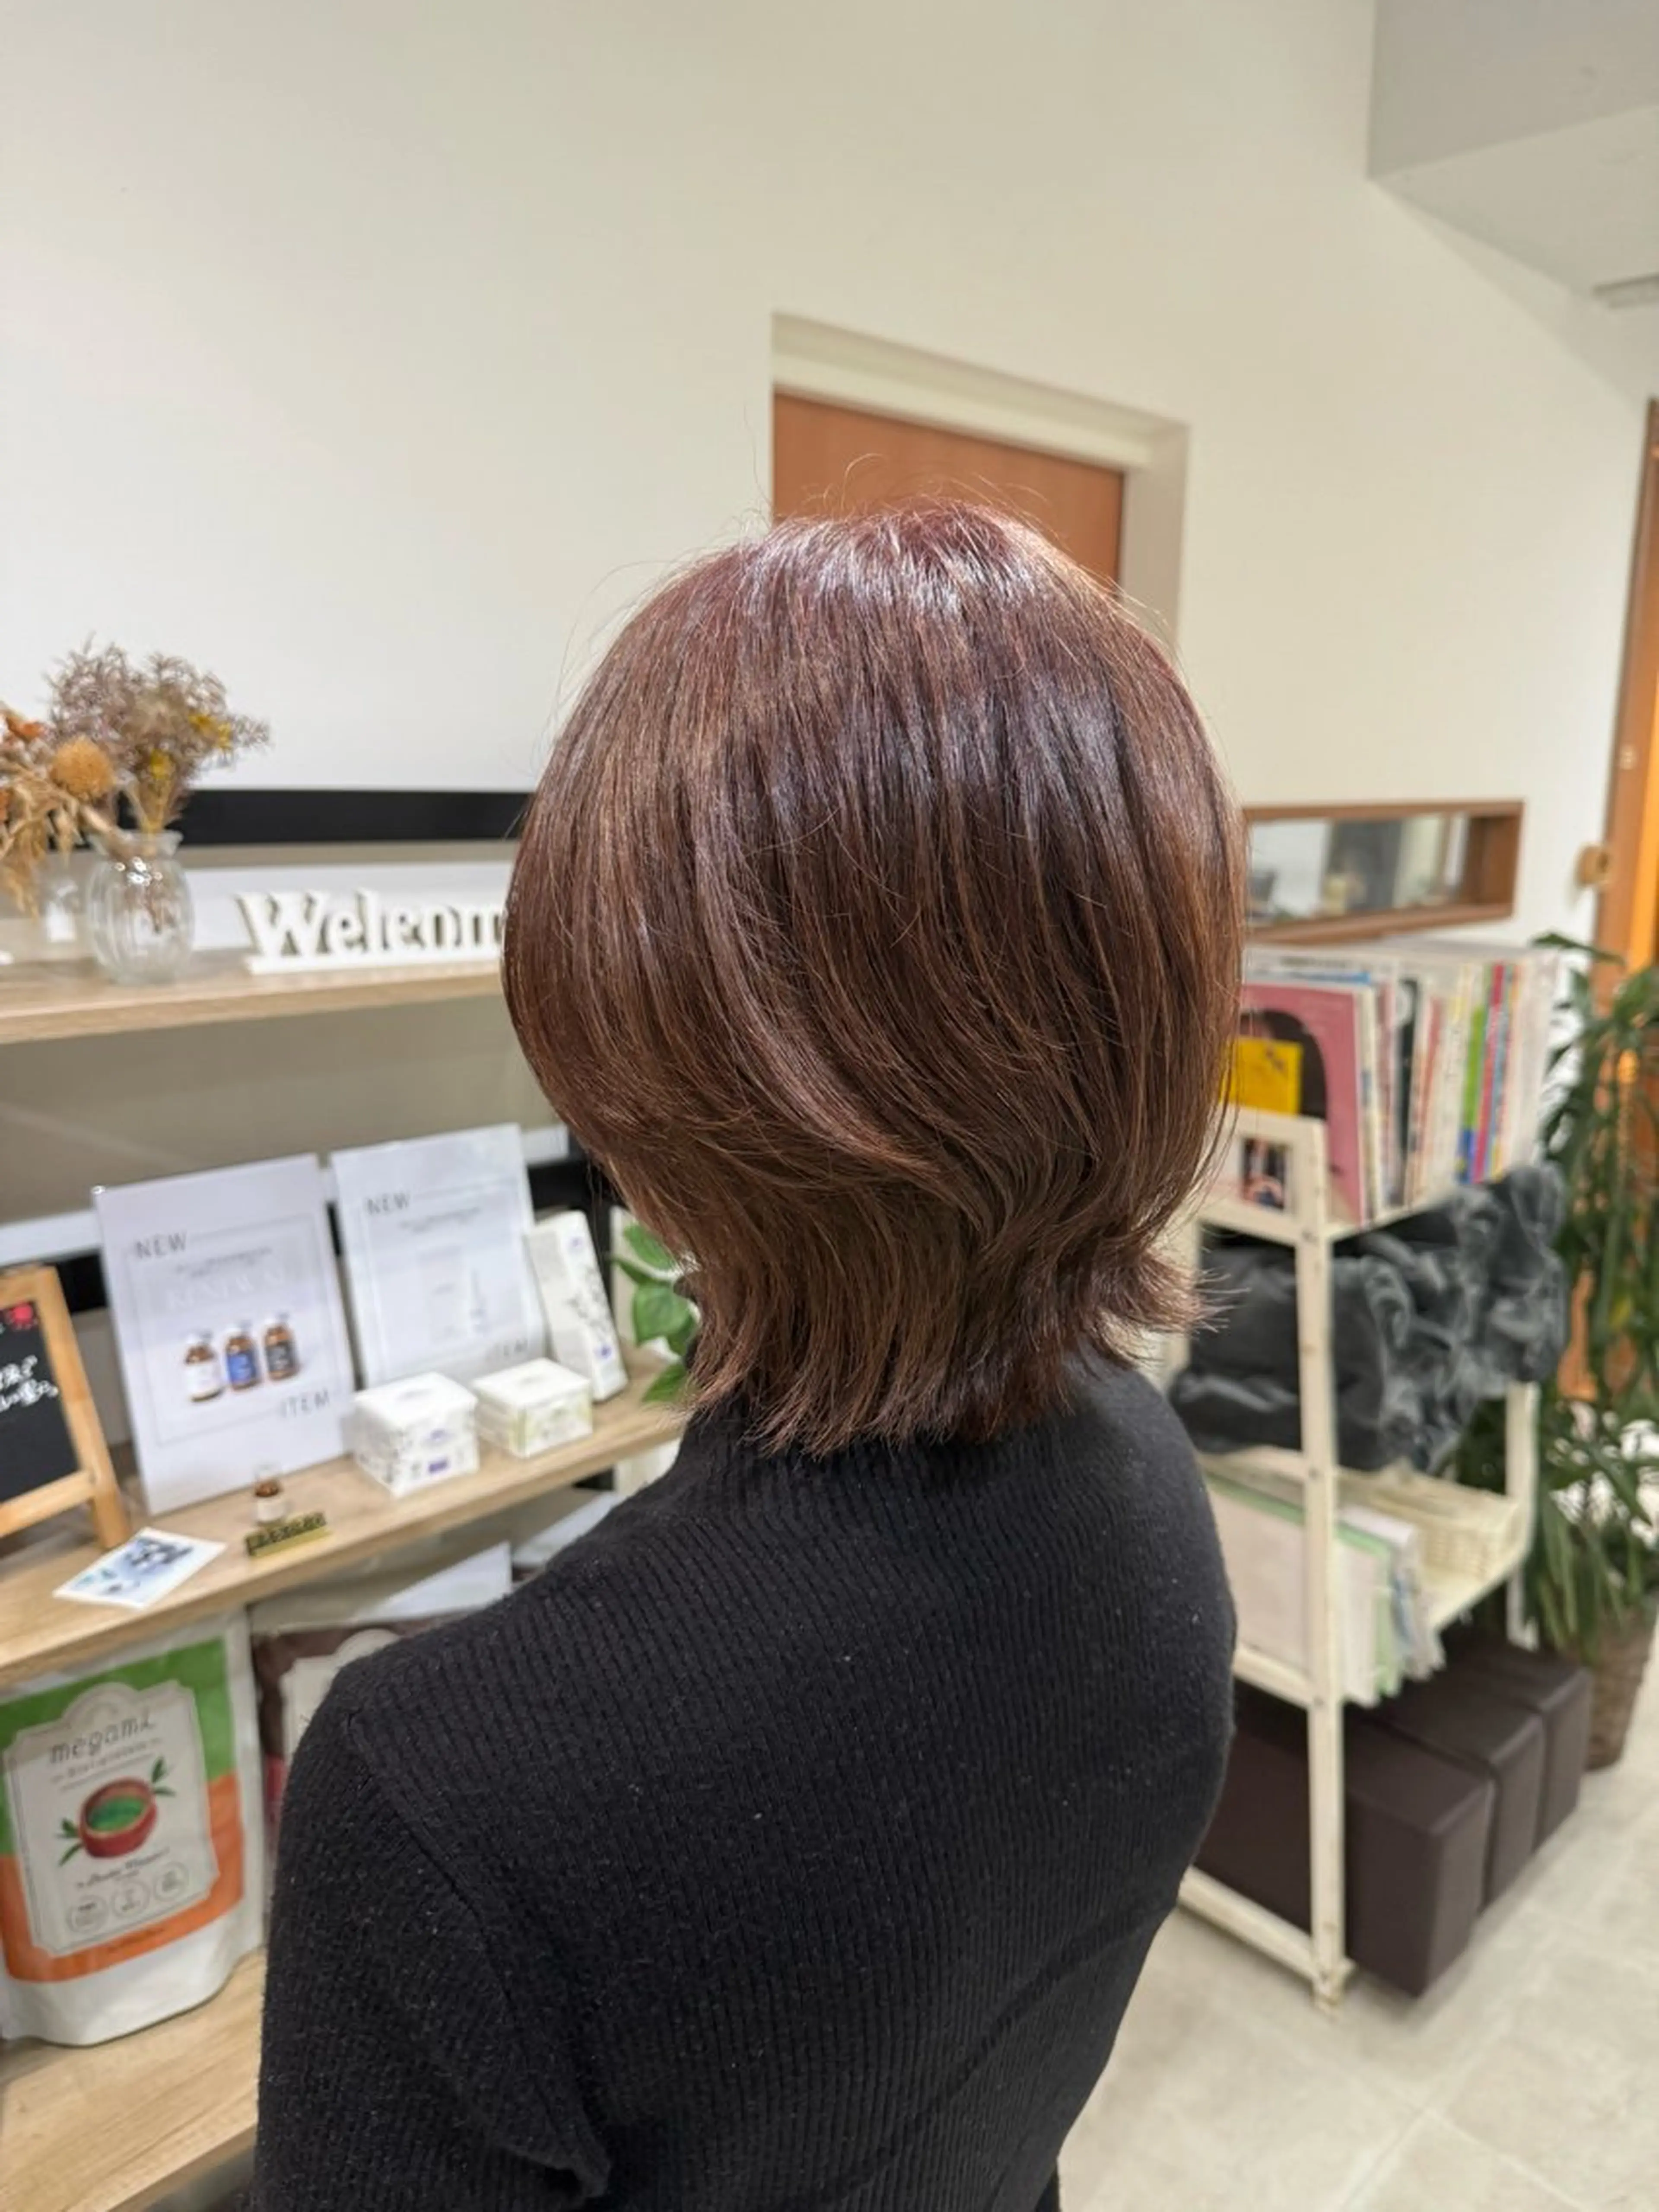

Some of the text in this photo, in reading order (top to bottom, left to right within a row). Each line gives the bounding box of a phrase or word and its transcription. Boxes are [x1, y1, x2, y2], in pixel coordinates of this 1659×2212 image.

[366, 1191, 410, 1216] NEW
[134, 1231, 187, 1259] NEW
[280, 1388, 331, 1419] ITEM
